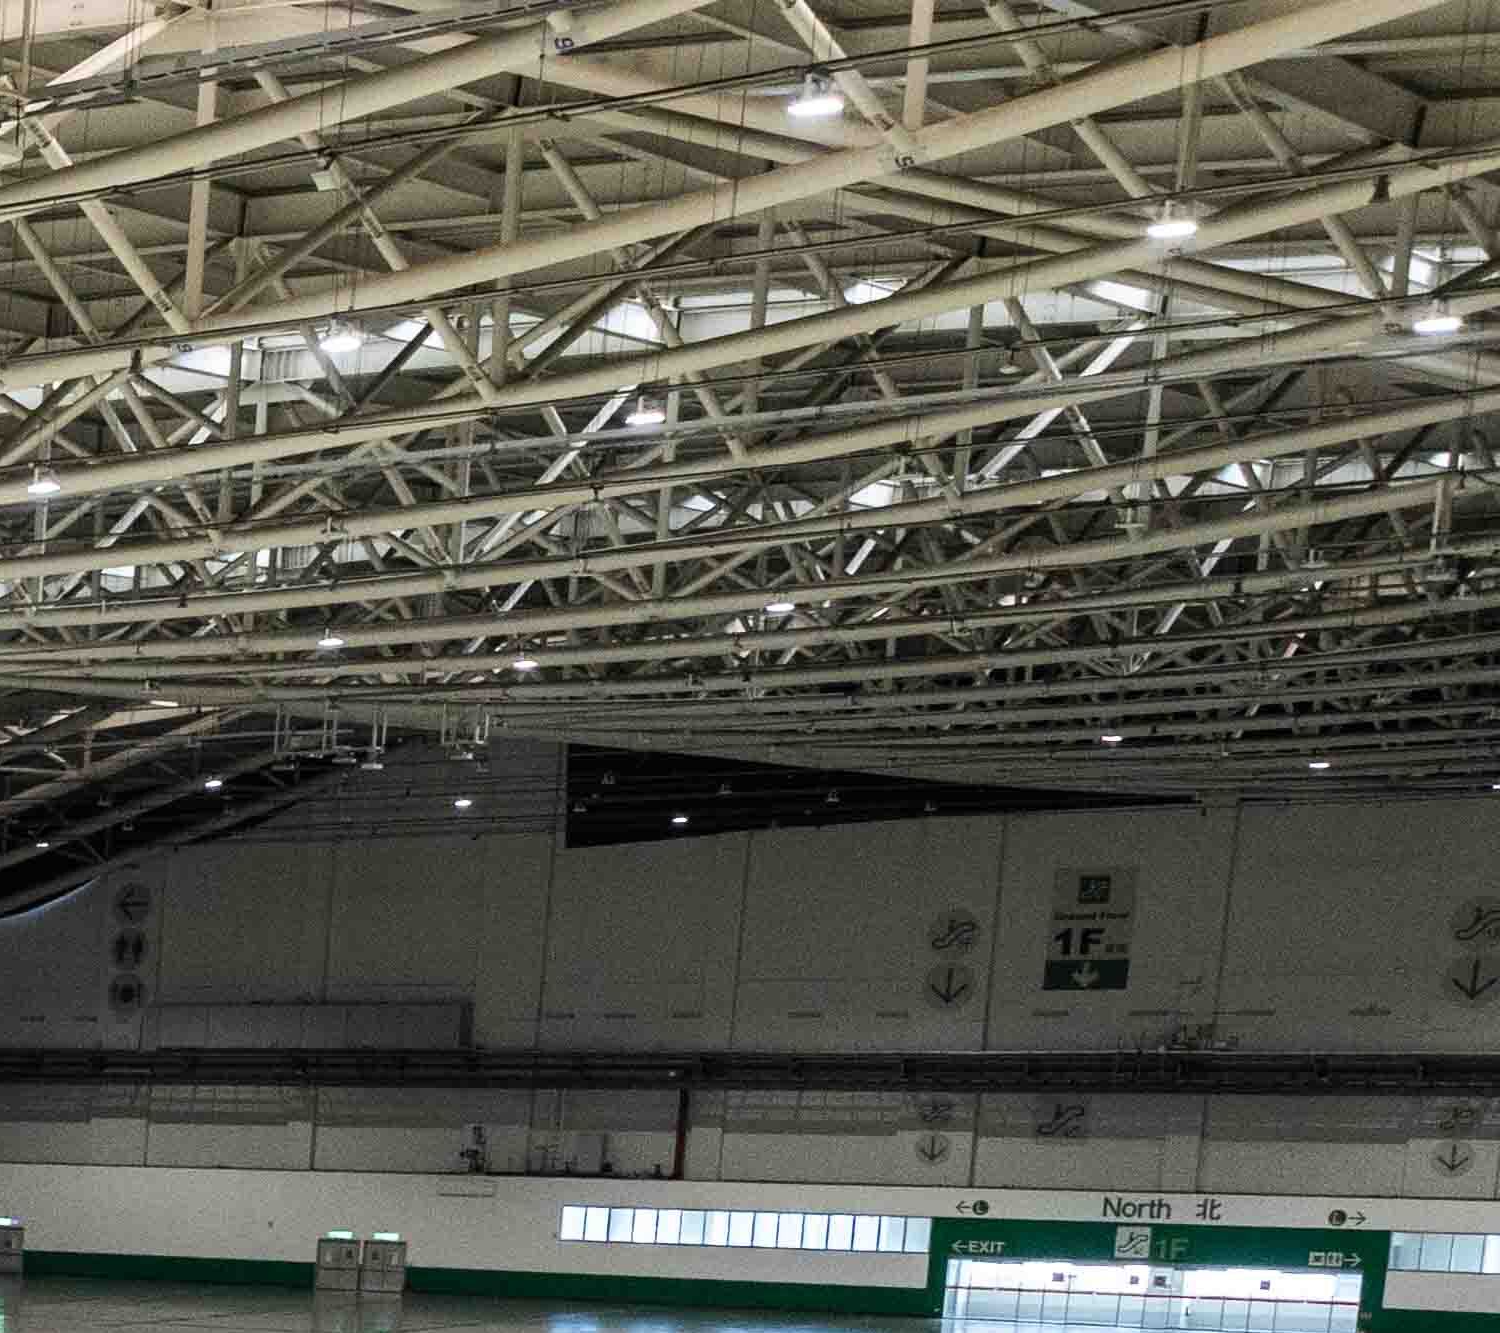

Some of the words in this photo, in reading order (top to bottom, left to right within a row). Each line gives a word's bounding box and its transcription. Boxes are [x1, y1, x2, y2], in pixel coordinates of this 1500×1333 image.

[1054, 928, 1106, 955] 1F
[1103, 1197, 1171, 1219] North
[1196, 1198, 1222, 1221] 北
[968, 1241, 1004, 1253] EXIT
[1156, 1237, 1188, 1260] 1F
